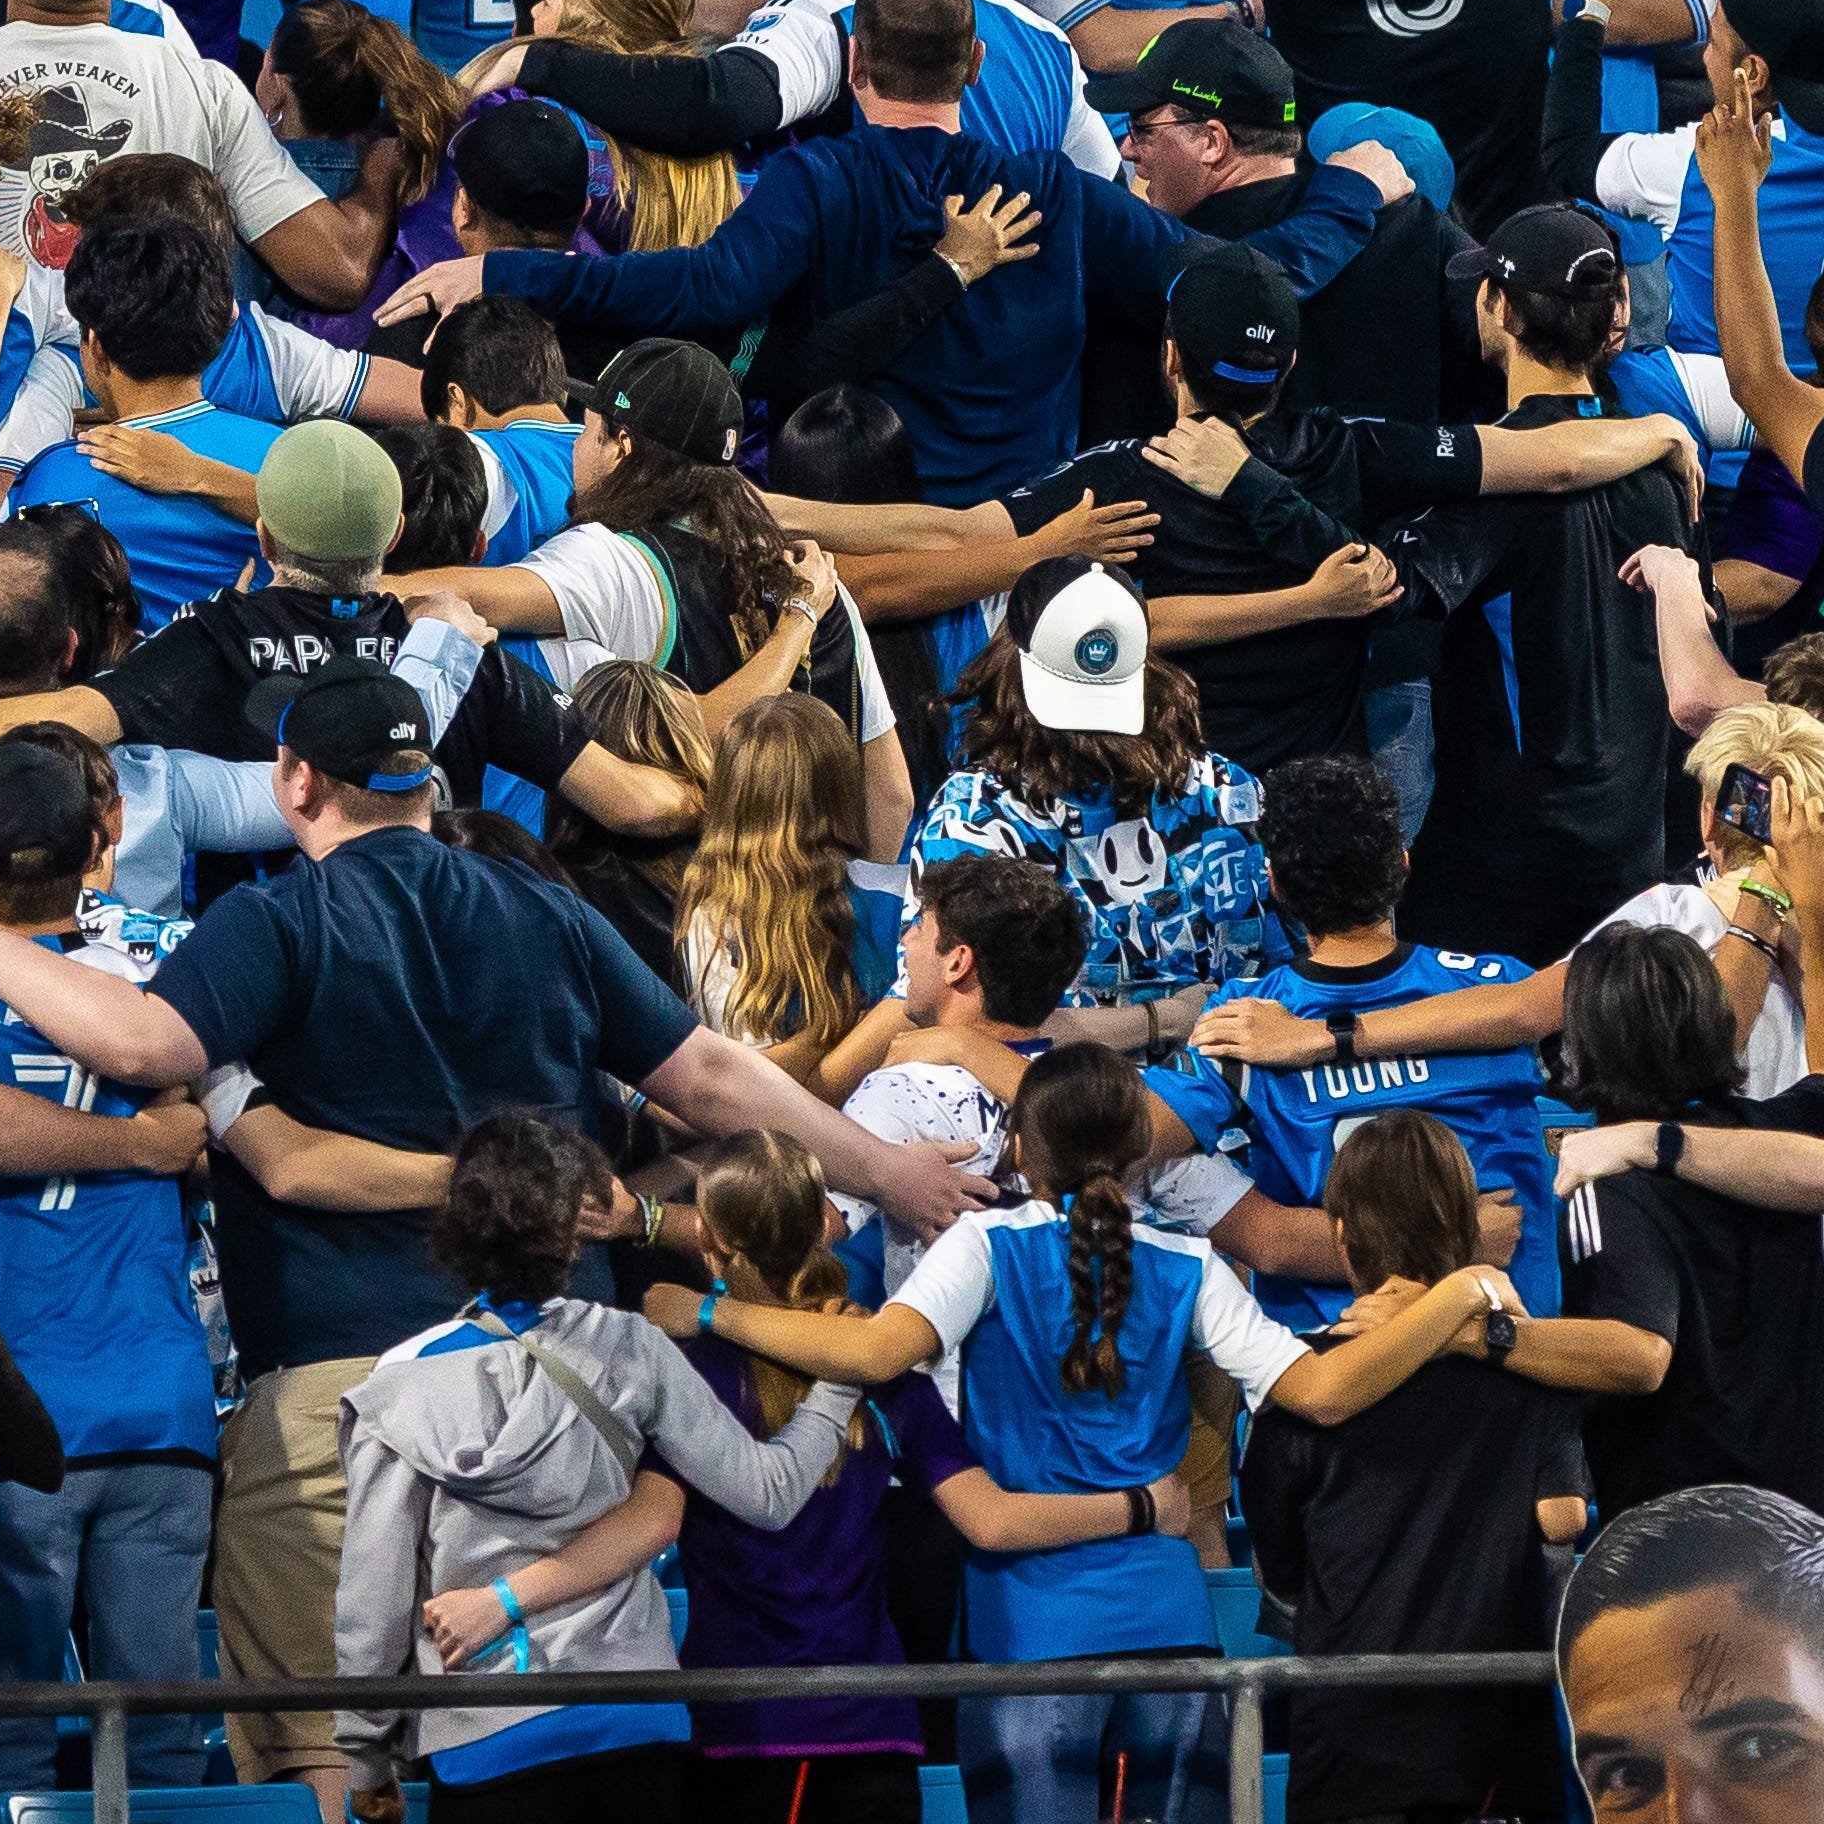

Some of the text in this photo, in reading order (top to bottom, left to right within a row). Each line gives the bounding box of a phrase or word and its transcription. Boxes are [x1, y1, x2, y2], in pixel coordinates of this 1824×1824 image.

[55, 62, 141, 99] WEAKEN
[1245, 324, 1276, 344] ally
[389, 722, 417, 741] ally
[1300, 1056, 1432, 1106] YOUNG
